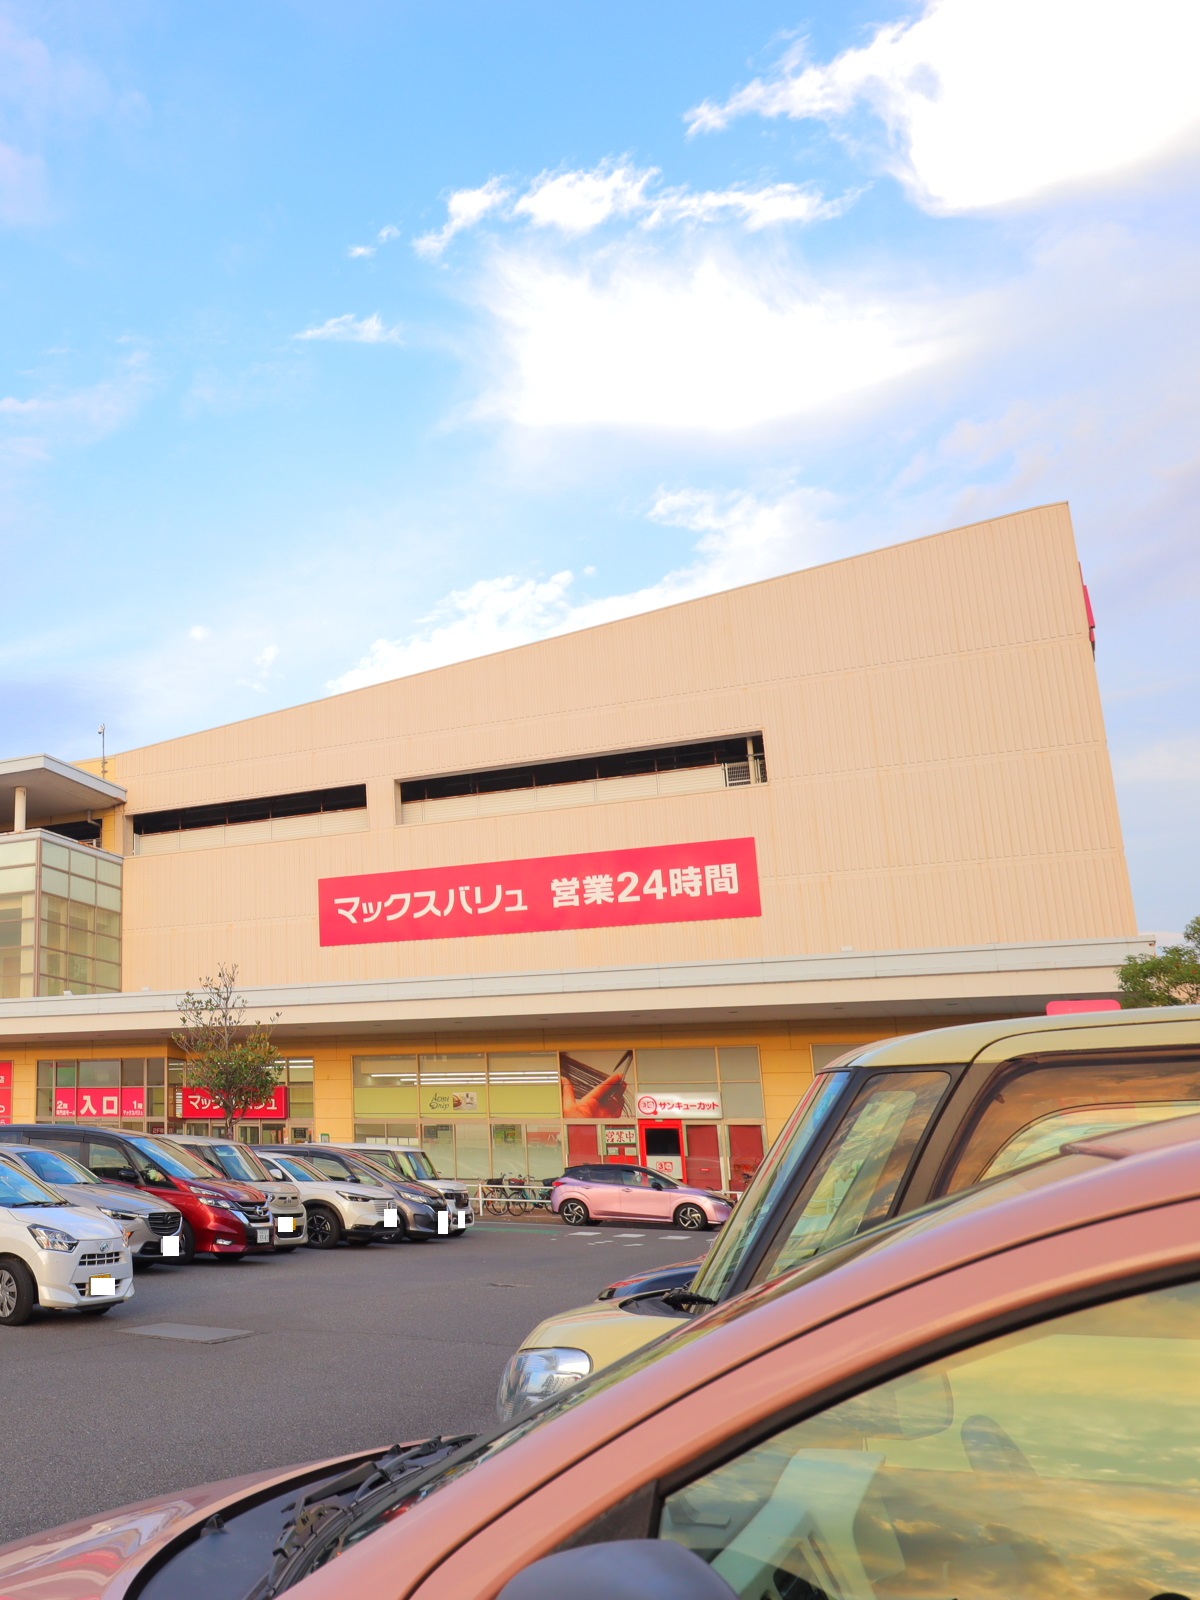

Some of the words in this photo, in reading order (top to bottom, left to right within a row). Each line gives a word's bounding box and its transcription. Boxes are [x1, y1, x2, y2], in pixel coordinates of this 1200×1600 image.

[333, 884, 528, 924] マックスバリュ
[550, 862, 739, 908] 営業24時間
[80, 1095, 118, 1115] 入口
[659, 1101, 719, 1110] サンキューカット
[605, 1131, 634, 1142] 営業中
